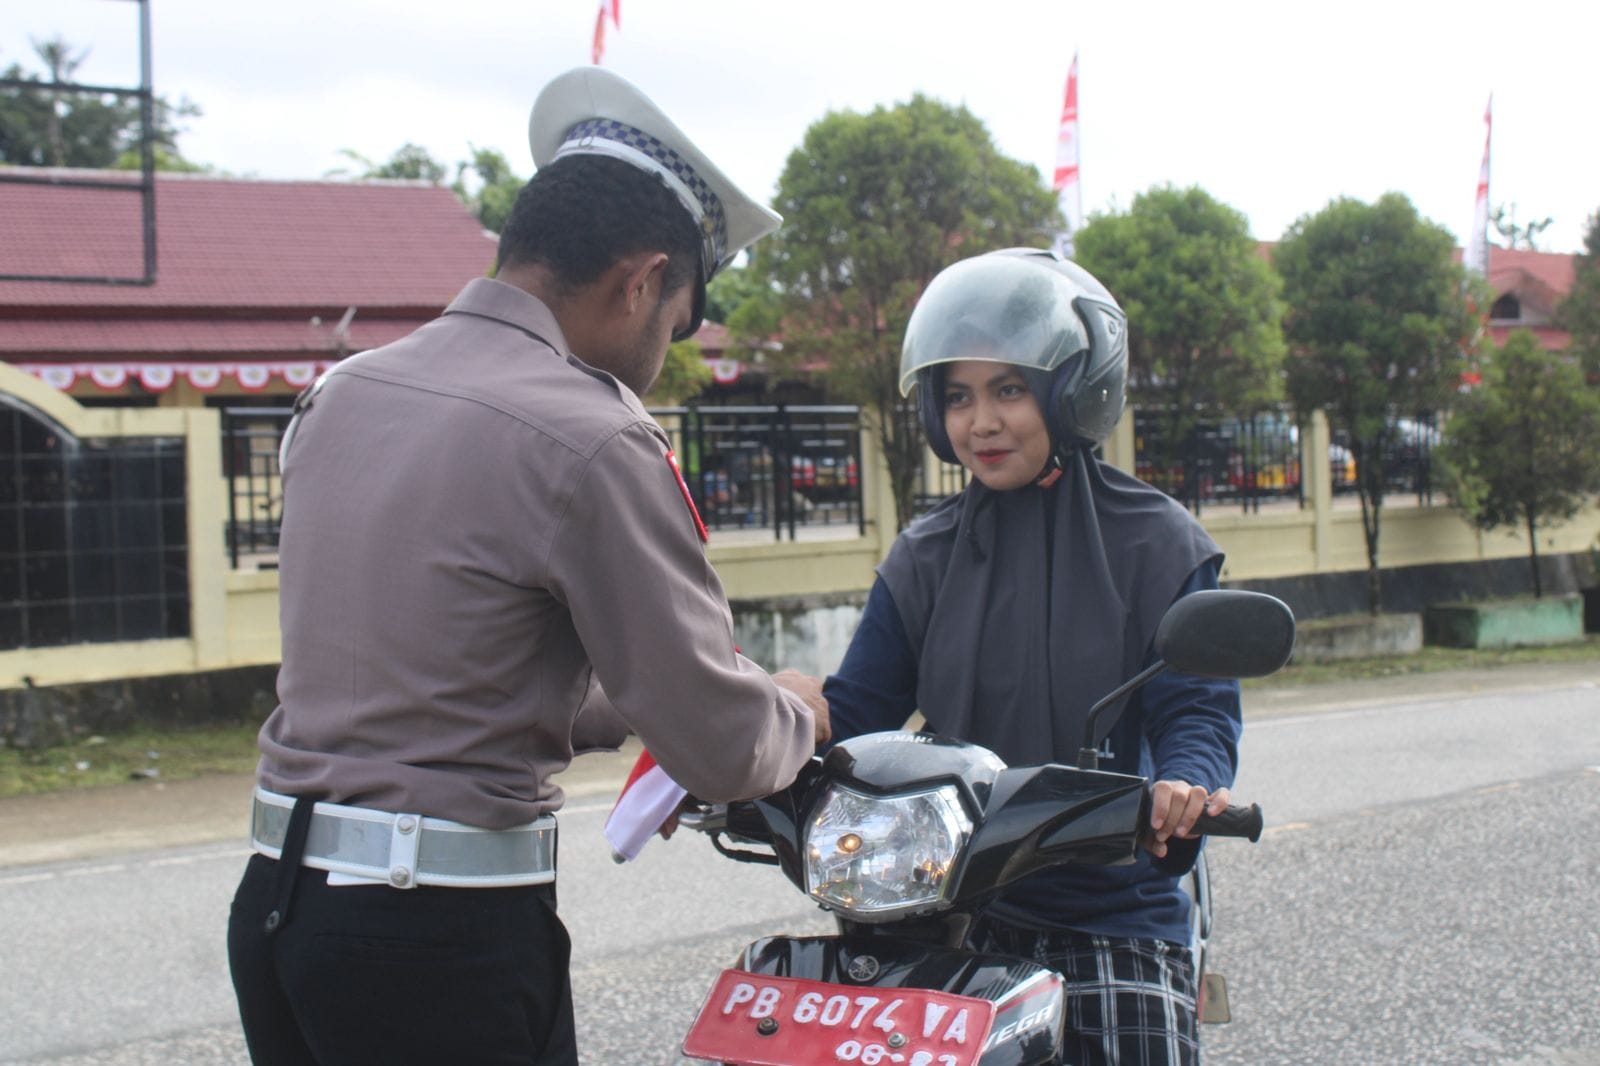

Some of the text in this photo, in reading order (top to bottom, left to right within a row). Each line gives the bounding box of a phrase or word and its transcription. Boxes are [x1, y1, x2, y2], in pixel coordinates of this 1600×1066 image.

[722, 982, 969, 1044] PB 6074 VA
